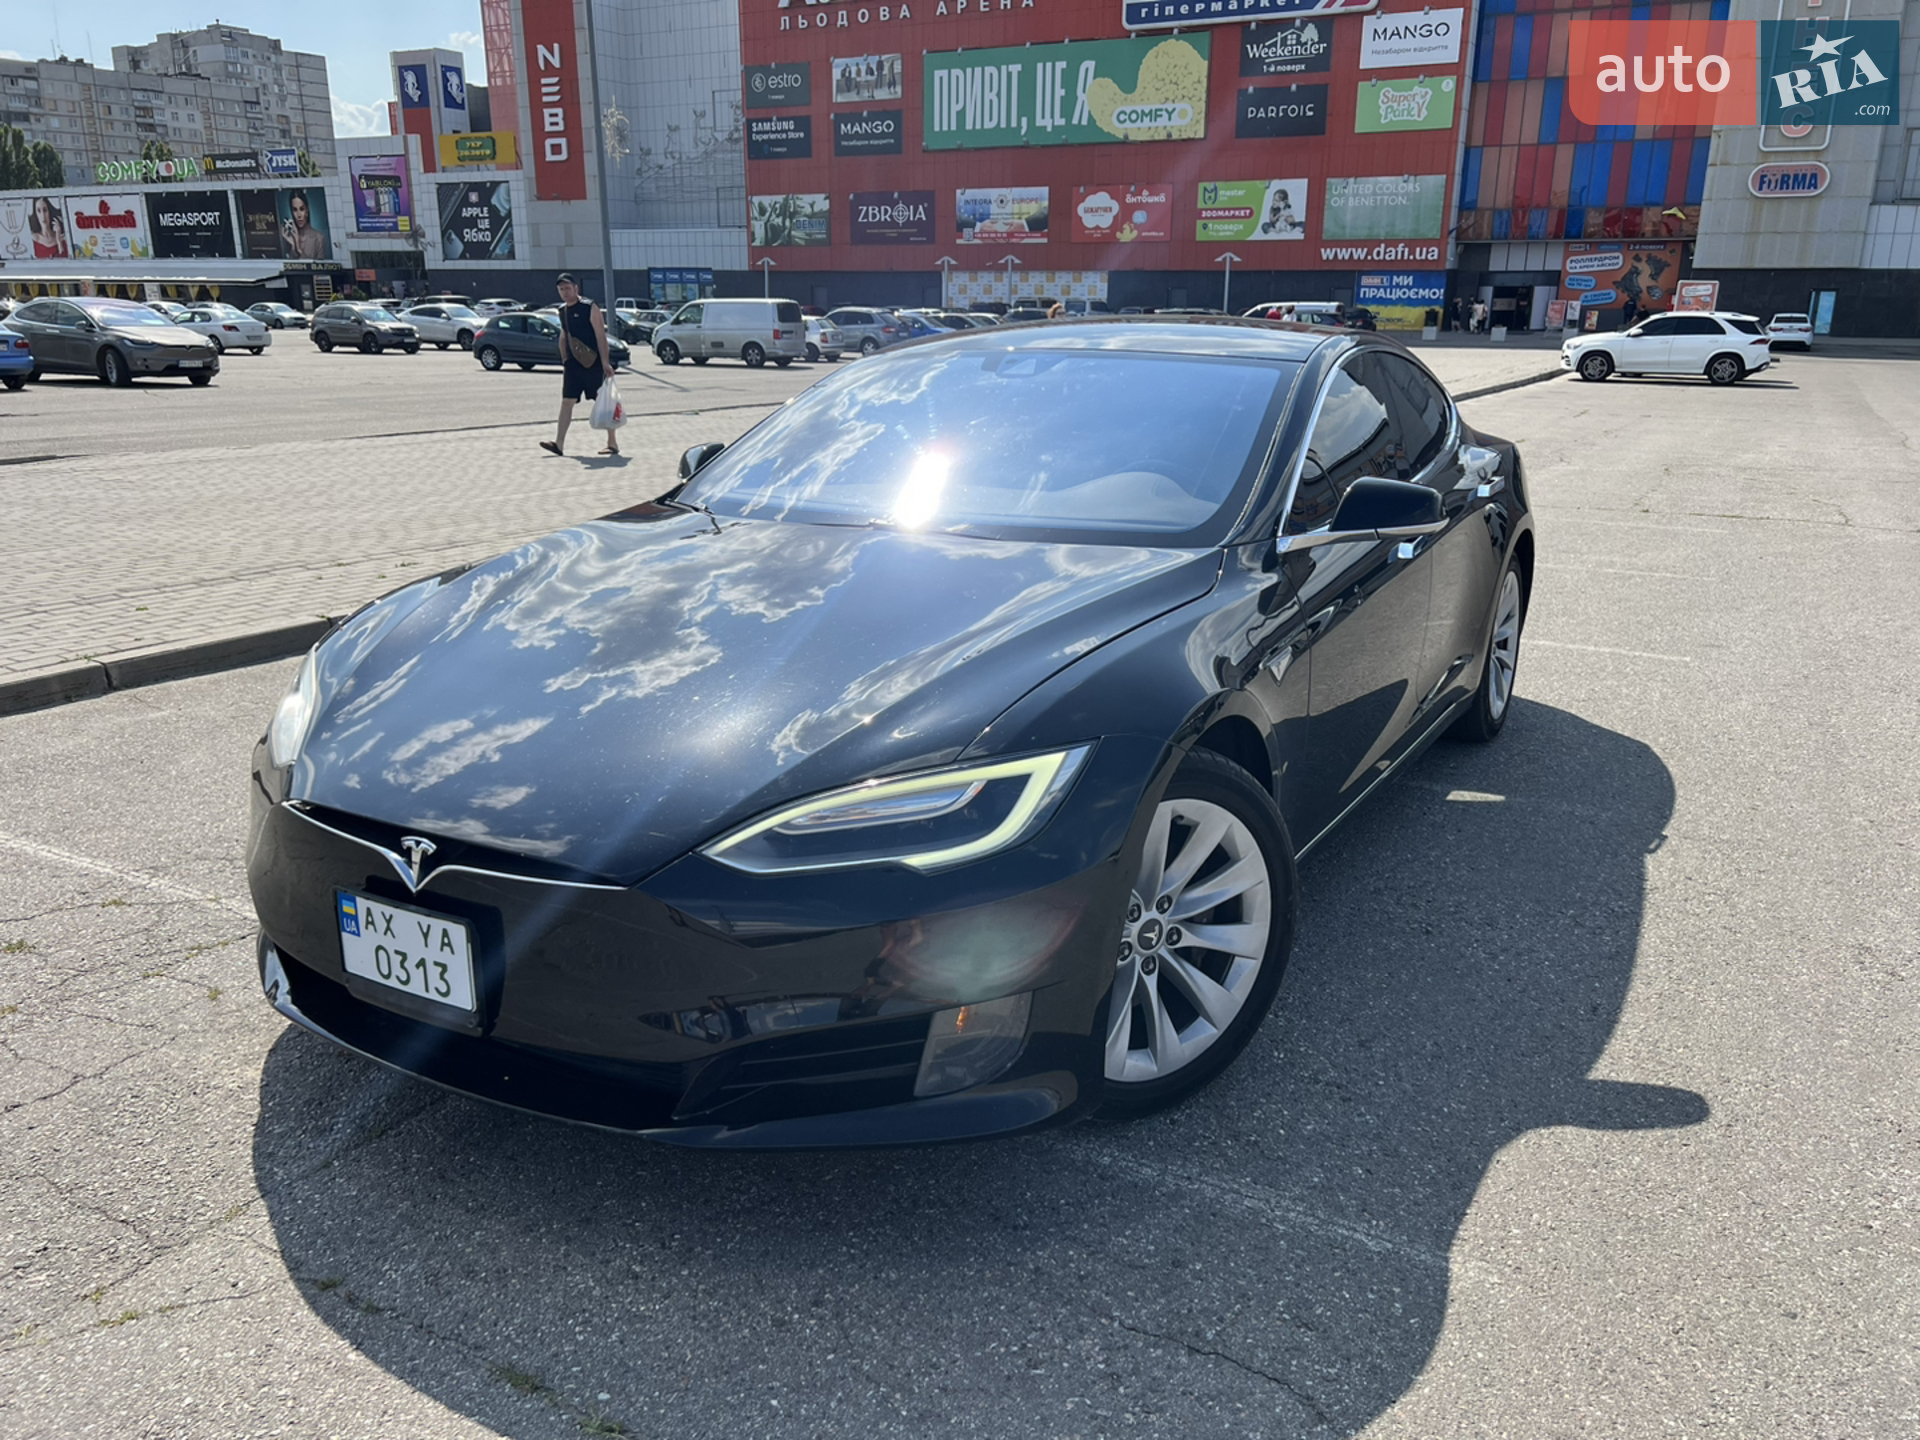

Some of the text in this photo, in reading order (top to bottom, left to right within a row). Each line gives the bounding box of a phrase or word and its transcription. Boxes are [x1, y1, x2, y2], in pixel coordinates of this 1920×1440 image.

[780, 4, 911, 31] ЛЬОДОВА
[1372, 22, 1450, 41] MANGO
[1246, 42, 1327, 58] Weekender
[768, 73, 802, 88] estro
[934, 60, 1096, 135] ПРИВІТ, ЦЕ Я
[1381, 89, 1418, 107] Super
[1116, 107, 1176, 124] COMFY
[1247, 104, 1314, 118] PARFOIS
[751, 120, 795, 132] SAMSUNG
[840, 120, 894, 135] MANGO
[752, 131, 804, 142] Experience Store
[271, 154, 296, 167] JYSK
[98, 157, 200, 182] COMFY UA
[1332, 183, 1421, 195] UNITED COLORS
[1331, 197, 1346, 207] OF
[159, 211, 220, 227] MEGASPORT
[461, 207, 489, 217] APPLE
[1202, 209, 1251, 217] ЗООМАРКЕТ
[477, 219, 491, 229] ЦЕ
[795, 219, 826, 229] DENIM
[463, 228, 492, 242] Ябко
[1320, 243, 1439, 261] www.dafi.ua
[1392, 275, 1413, 286] МИ
[1360, 287, 1444, 300] ПРАЦЮЄМО!
[343, 917, 358, 934] UA
[364, 906, 455, 955] AX YA
[374, 944, 450, 998] 0313
